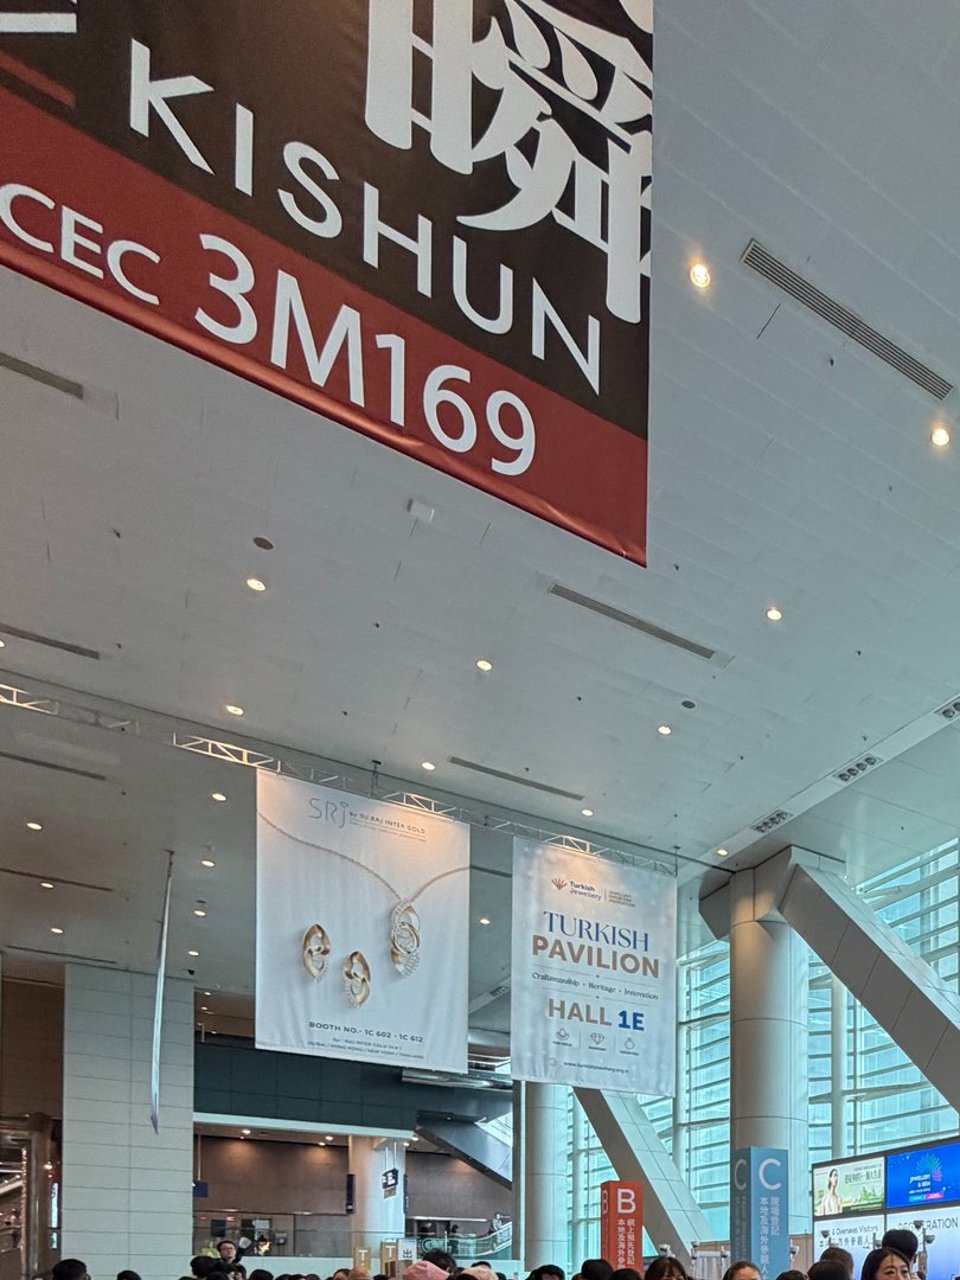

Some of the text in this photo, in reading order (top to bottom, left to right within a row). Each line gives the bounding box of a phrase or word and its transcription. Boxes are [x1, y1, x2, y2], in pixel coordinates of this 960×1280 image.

[130, 38, 600, 395] KISHUN
[0, 183, 536, 476] CEC 3M169
[570, 881, 596, 892] Turkish
[543, 910, 649, 952] TURKISH
[532, 934, 659, 979] PAVILION
[624, 987, 659, 1000] Innovation
[309, 1021, 341, 1031] BOOTH
[376, 1030, 392, 1038] 602
[548, 998, 645, 1031] HALL 1E
[734, 1158, 747, 1191] C
[759, 1158, 782, 1190] C
[602, 1189, 609, 1215] B
[617, 1188, 636, 1214] B
